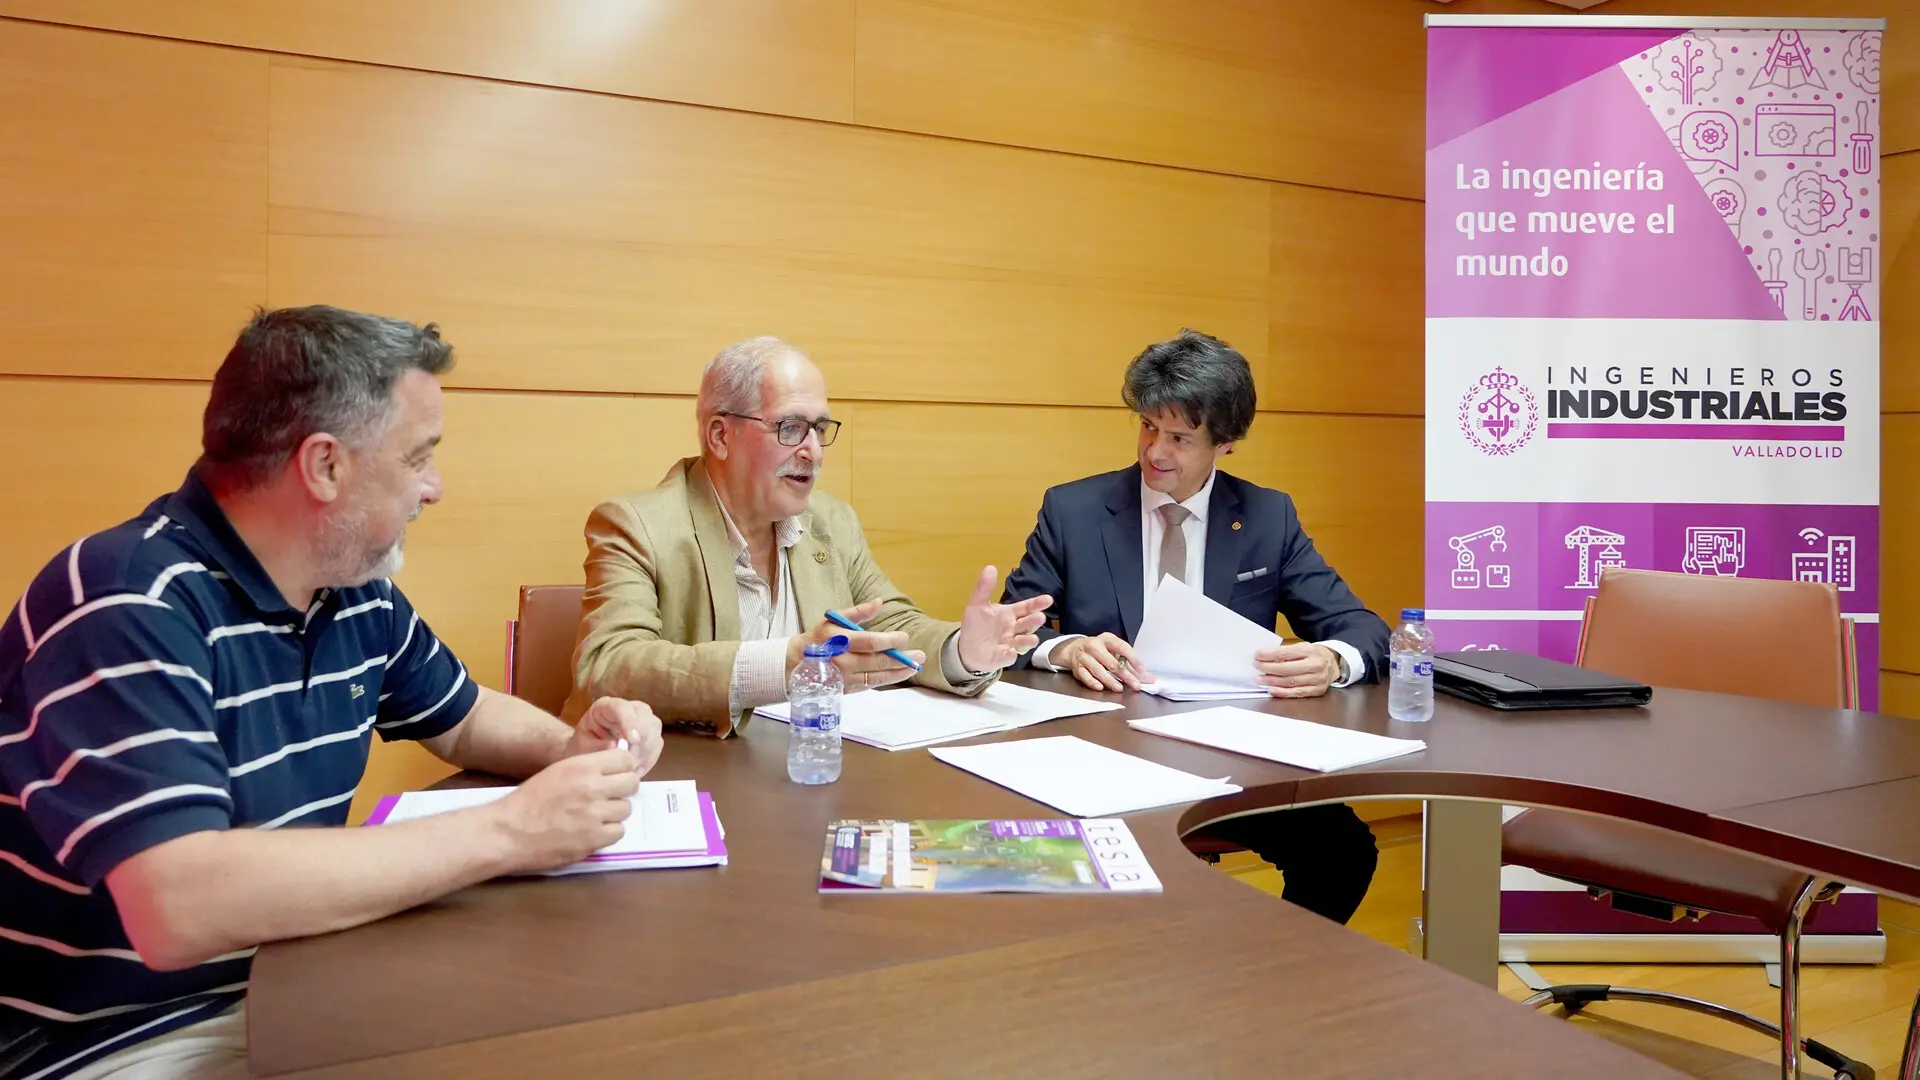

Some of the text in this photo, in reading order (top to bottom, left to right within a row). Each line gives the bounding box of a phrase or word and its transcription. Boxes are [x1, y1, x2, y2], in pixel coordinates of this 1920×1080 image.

[1455, 160, 1665, 197] La ingeniería
[1455, 204, 1675, 240] que mueve el
[1455, 246, 1569, 277] mundo
[1547, 366, 1844, 387] INGENIEROS
[1547, 389, 1848, 421] INDUSTRIALES
[1732, 445, 1844, 459] VALLADOLID
[1087, 826, 1141, 882] tesla
